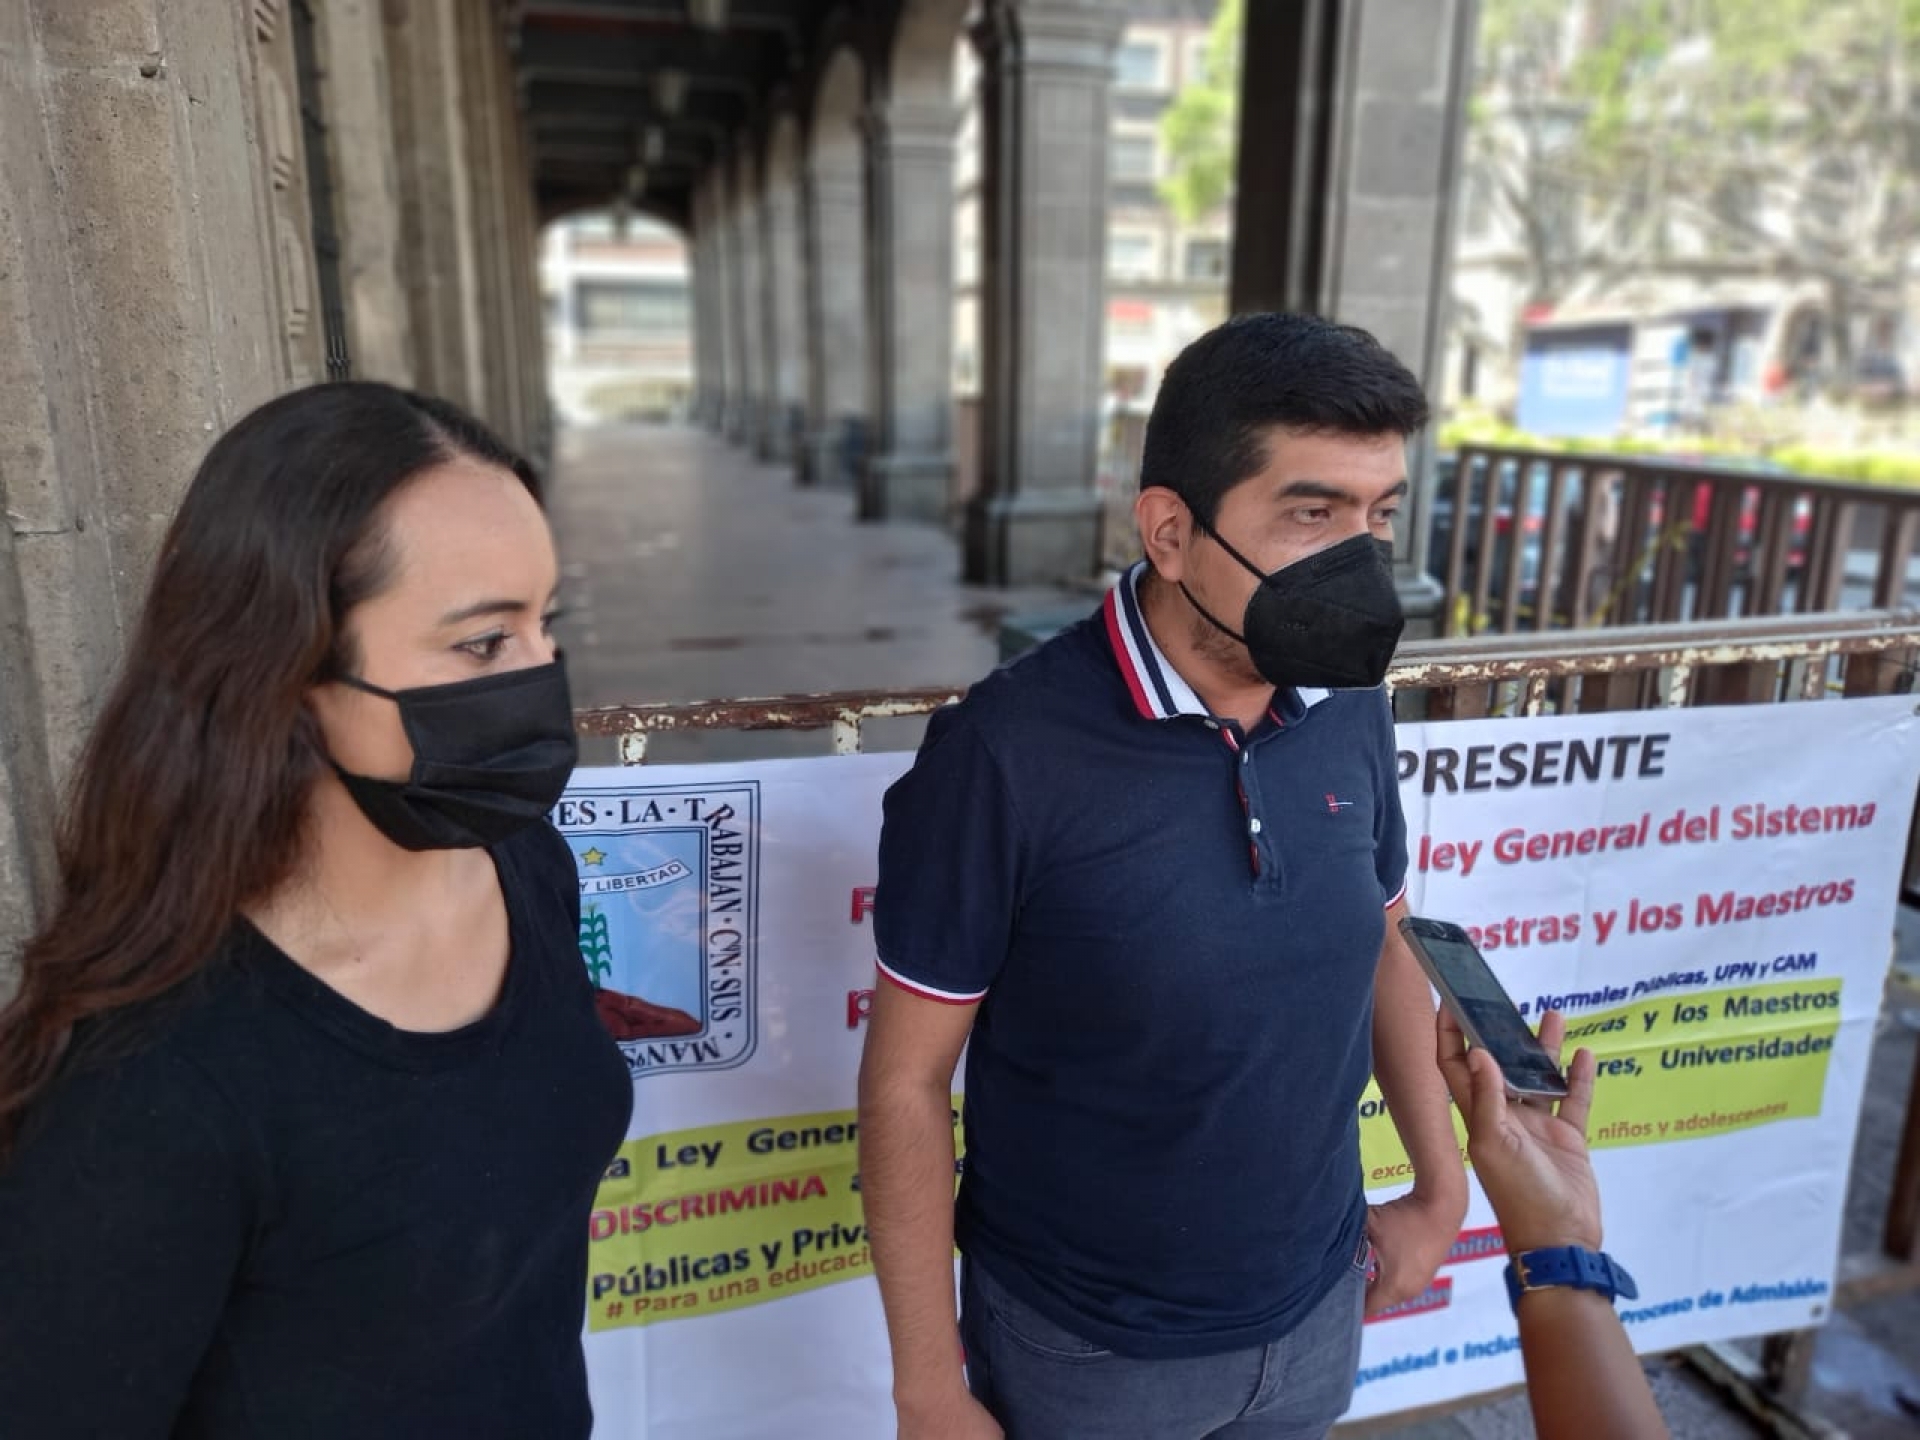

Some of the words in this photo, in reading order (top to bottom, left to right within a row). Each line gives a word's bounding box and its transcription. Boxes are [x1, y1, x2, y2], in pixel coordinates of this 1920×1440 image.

[1418, 833, 1483, 877] ley
[1494, 812, 1651, 864] General
[1658, 805, 1720, 844] del
[1731, 802, 1877, 840] Sistema
[596, 863, 683, 892] LIBERTAD
[619, 797, 663, 824] LA
[710, 977, 742, 1021] SUS
[1593, 909, 1618, 945] y
[1627, 897, 1684, 934] los
[1695, 877, 1855, 927] Maestros
[1535, 986, 1629, 1014] Normales
[1715, 961, 1757, 982] UPN
[1773, 952, 1817, 973] CAM
[1643, 1010, 1659, 1032] y
[1672, 1002, 1709, 1025] los
[1724, 990, 1840, 1018] Maestros
[1660, 1033, 1834, 1070] Universidades
[1598, 1121, 1652, 1140] niños
[1658, 1120, 1670, 1137] y
[1673, 1101, 1789, 1132] adolescentes
[656, 1139, 723, 1170] Ley
[589, 1174, 828, 1242] DISCRIMINA
[592, 1246, 750, 1300] Públicas
[760, 1241, 782, 1270] y
[634, 1291, 699, 1315] Para
[708, 1277, 760, 1302] una
[1698, 1289, 1724, 1309] de
